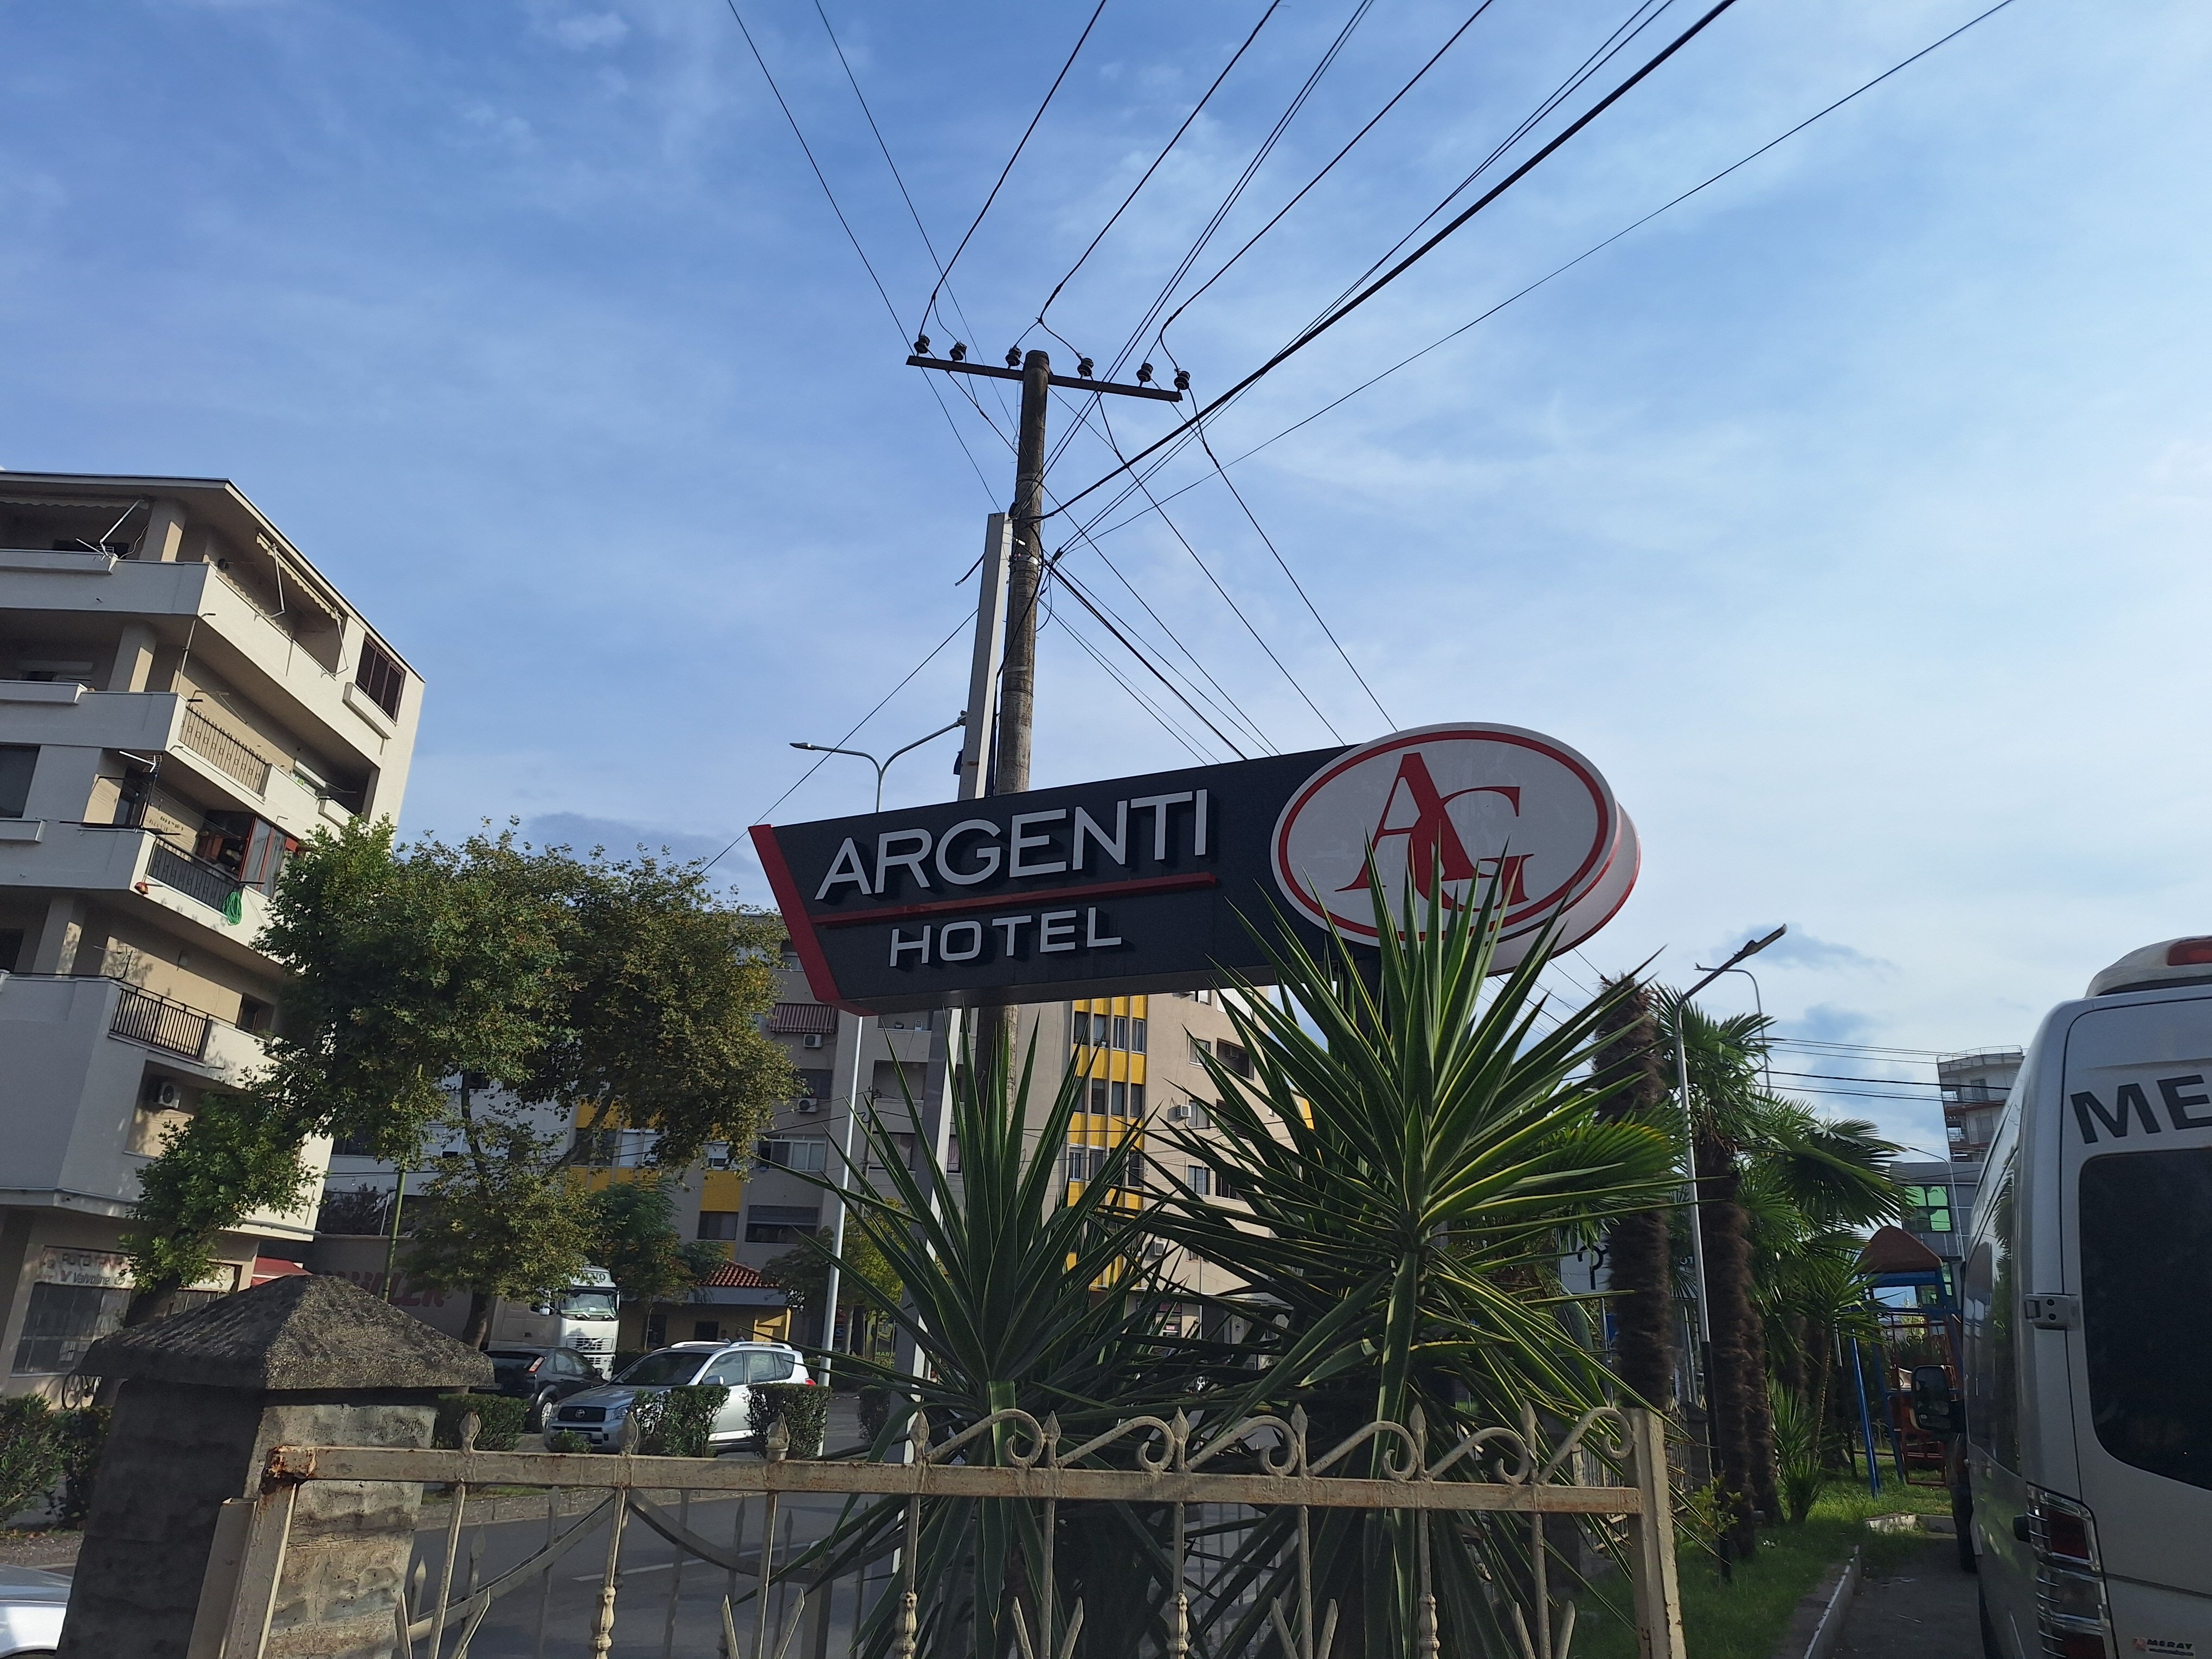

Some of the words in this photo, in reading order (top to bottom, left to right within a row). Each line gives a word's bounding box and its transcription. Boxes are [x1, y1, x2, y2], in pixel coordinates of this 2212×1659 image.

[815, 789, 1208, 900] ARGENTI
[889, 907, 1122, 967] HOTEL
[2070, 1075, 2212, 1144] ME
